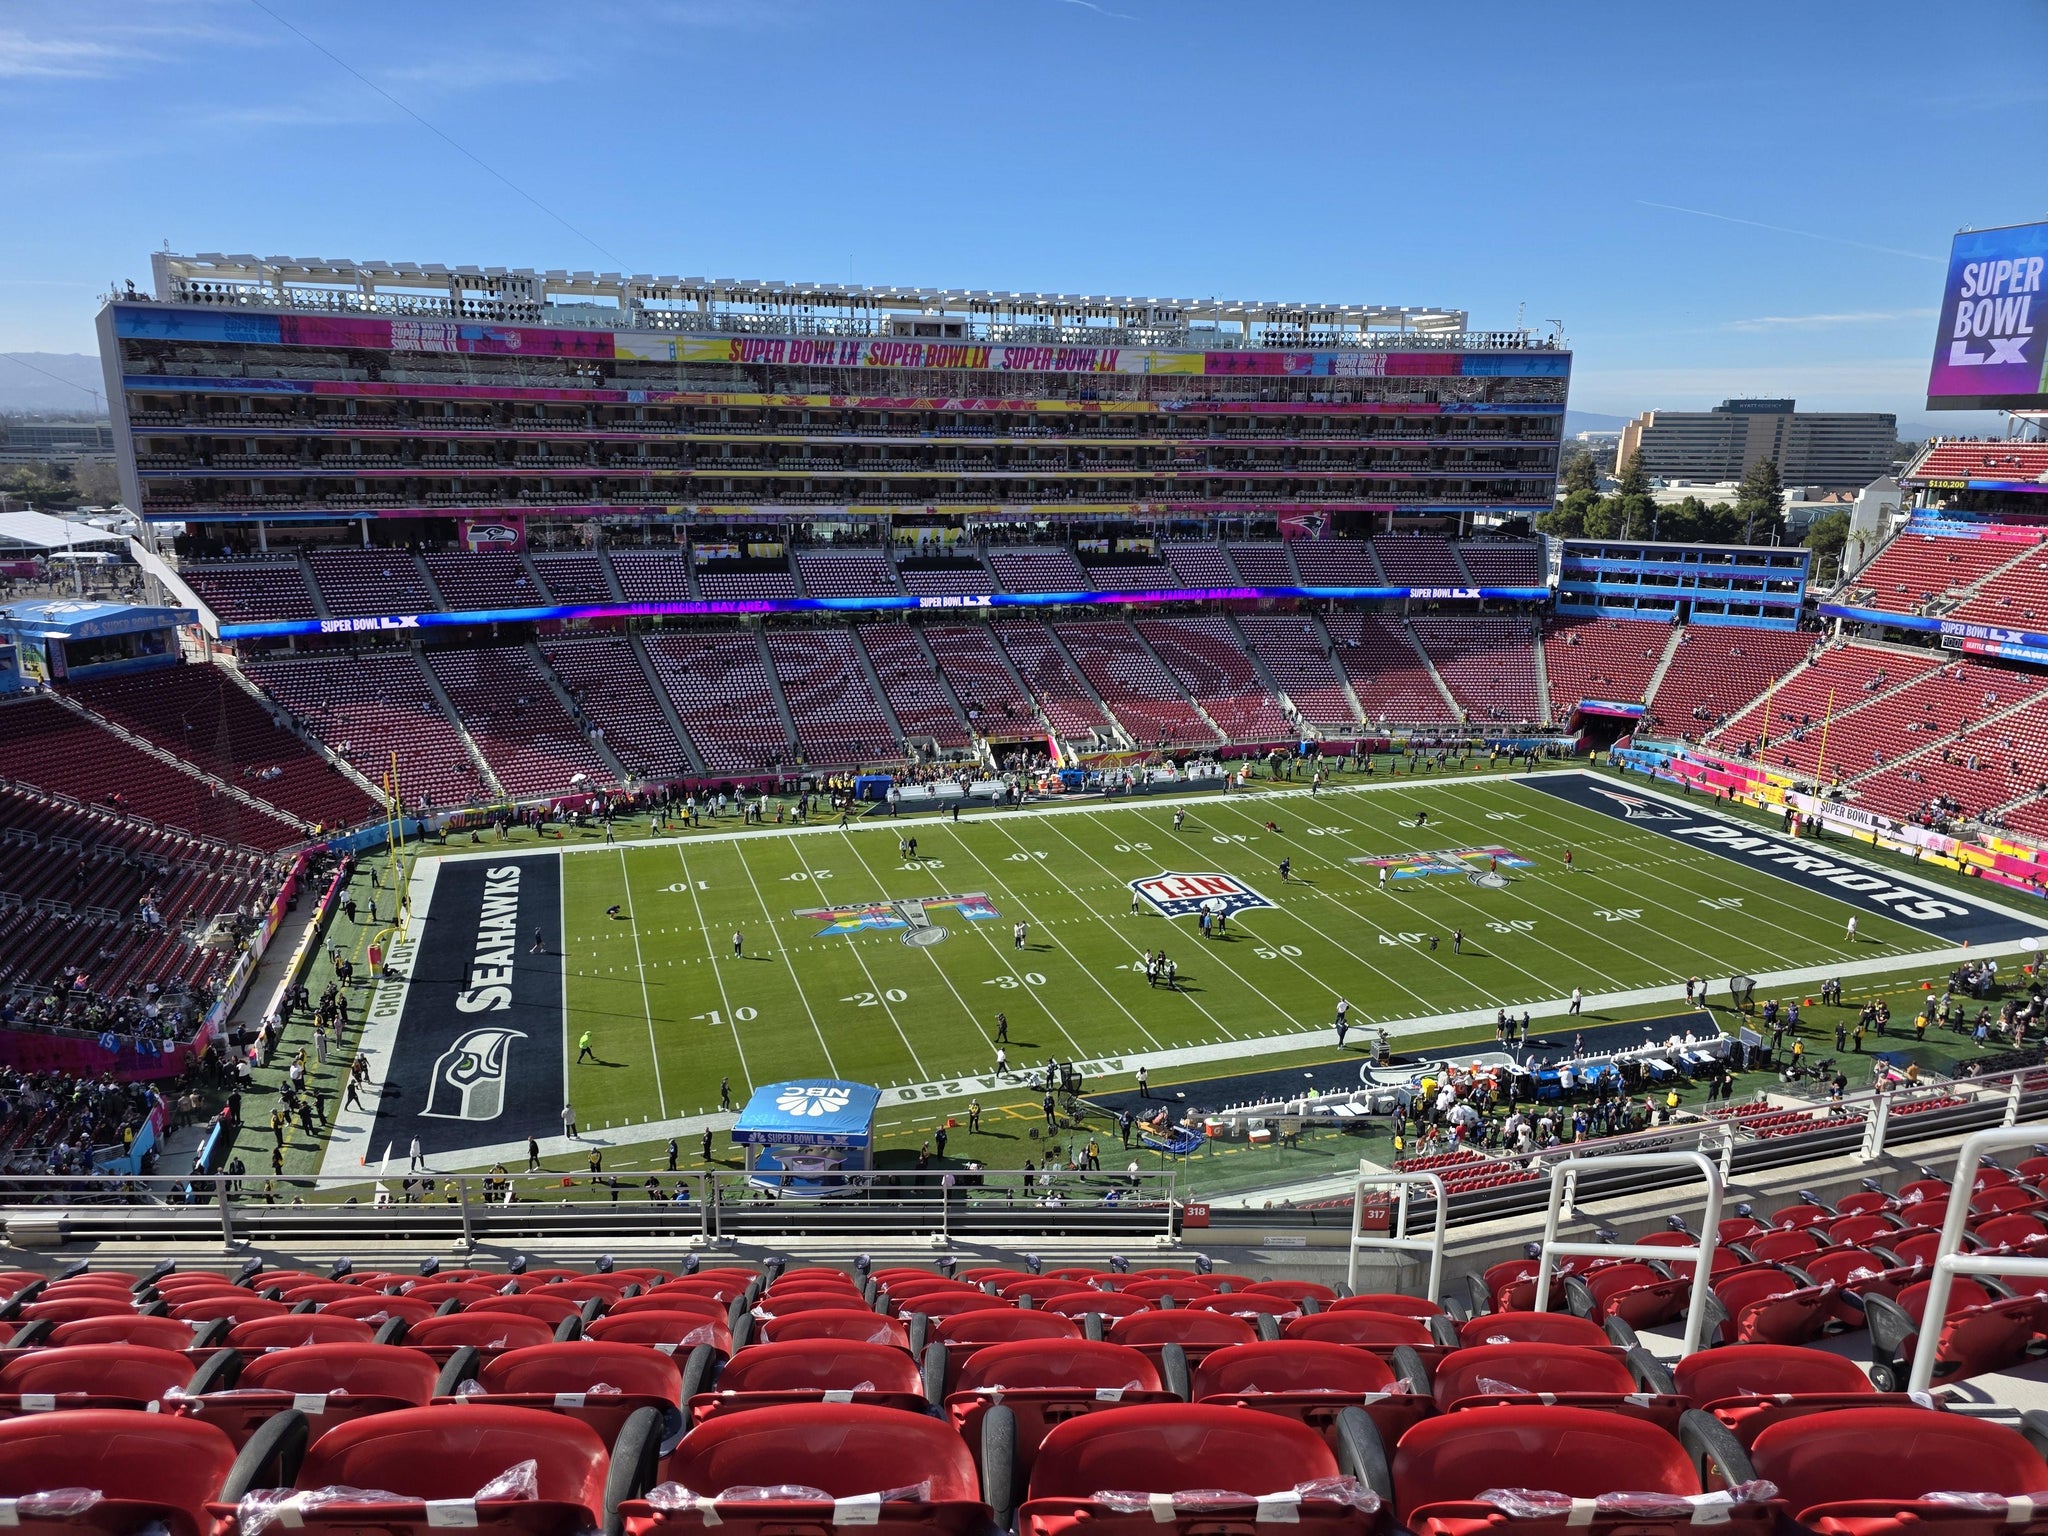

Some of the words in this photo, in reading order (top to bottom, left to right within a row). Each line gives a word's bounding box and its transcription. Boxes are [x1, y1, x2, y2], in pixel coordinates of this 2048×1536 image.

[1960, 256, 2044, 298] SUPER
[1953, 295, 2034, 339] BOWL
[391, 328, 420, 340] SUPER
[421, 329, 445, 341] BOWL
[447, 330, 458, 342] LX
[729, 338, 786, 363] SUPER
[789, 339, 835, 364] BOWL
[839, 341, 860, 366] LX
[868, 343, 922, 367] SUPER
[925, 345, 968, 368] BOWL
[972, 346, 992, 369] LX
[1948, 336, 2032, 366] LX
[1002, 347, 1053, 370] SUPER
[1055, 349, 1099, 372] BOWL
[1100, 349, 1120, 372] LX
[1335, 358, 1359, 368] SUPER
[1359, 359, 1378, 368] BOWL
[1928, 479, 1965, 489] $110,200
[1145, 591, 1161, 600] SAN
[1163, 589, 1206, 600] FRANCISCO
[1208, 588, 1230, 598] BAY
[1230, 587, 1258, 598] AREA
[1410, 588, 1432, 599] SUPER
[1432, 588, 1452, 598] BOWL
[1452, 588, 1481, 598] LX
[631, 603, 650, 614] SAN
[653, 602, 707, 614] FRANCISCO
[711, 601, 737, 612] BAY
[737, 601, 770, 612] AREA
[920, 597, 942, 608] SUPER
[943, 597, 963, 607] BOWL
[964, 595, 992, 607] LX
[102, 619, 130, 634] SUPER
[157, 611, 191, 627] LX
[321, 619, 351, 633] SUPER
[352, 617, 380, 632] BOWL
[381, 615, 420, 629] LX
[1941, 621, 1965, 636] SUPER
[1966, 626, 1989, 640] BOWL
[1989, 628, 2025, 644] LX
[1966, 641, 1985, 651] SEATTLE
[1485, 812, 1520, 821] 10
[1820, 800, 1846, 820] SUPER
[1846, 807, 1869, 825] BOWL
[1871, 815, 1910, 836] LX
[1307, 826, 1344, 836] 30
[1212, 834, 1249, 845] 40
[1718, 815, 1778, 835] TAKES
[1780, 836, 1818, 849] ALL
[1824, 850, 1857, 860] OF
[1858, 862, 1893, 872] US
[1114, 842, 1154, 853] 50
[1011, 851, 1049, 863] 40
[904, 860, 945, 871] 30
[1672, 825, 1970, 920] PATRIOTS
[790, 869, 834, 882] 20
[667, 880, 710, 893] 10
[1142, 877, 1240, 899] NFL
[818, 901, 881, 912] BOWL
[1698, 896, 1741, 910] 10
[1593, 908, 1640, 923] 20
[1486, 918, 1534, 934] 30
[456, 865, 521, 1013] SEAHAWKS
[1378, 931, 1423, 947] 40
[389, 938, 417, 966] LOVE
[1253, 944, 1303, 960] 50
[994, 972, 1047, 990] 30
[374, 969, 408, 1018] CHOOS
[852, 988, 909, 1007] 20
[705, 1006, 758, 1026] 10
[782, 1087, 851, 1098] NBC
[898, 1082, 963, 1101] 250
[1213, 1127, 1221, 1135] G
[768, 1133, 792, 1144] SUPER
[794, 1134, 816, 1145] BOWL
[817, 1135, 849, 1146] LX
[1187, 1206, 1206, 1216] 318
[1367, 1209, 1386, 1219] 317
